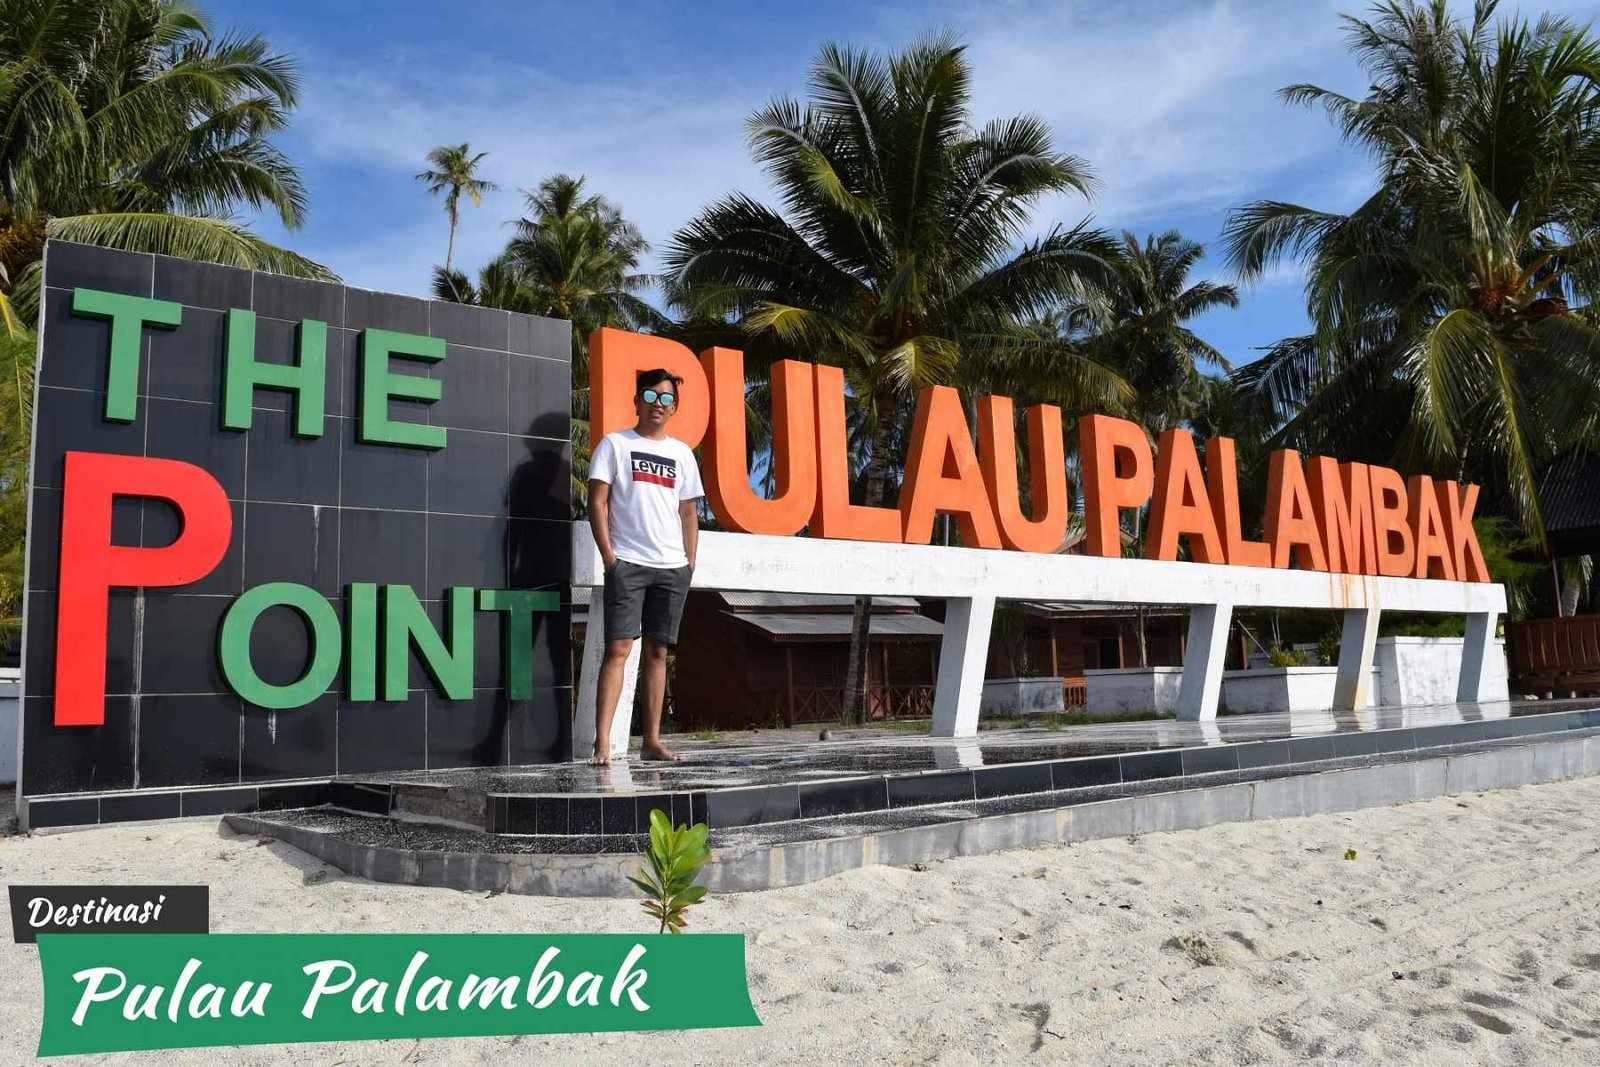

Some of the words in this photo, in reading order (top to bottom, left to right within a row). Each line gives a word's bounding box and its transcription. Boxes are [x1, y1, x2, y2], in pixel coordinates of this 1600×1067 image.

[72, 287, 447, 450] THE
[589, 327, 1068, 553] PULAU
[1079, 414, 1490, 583] PALAMBAK
[54, 451, 560, 727] POINT
